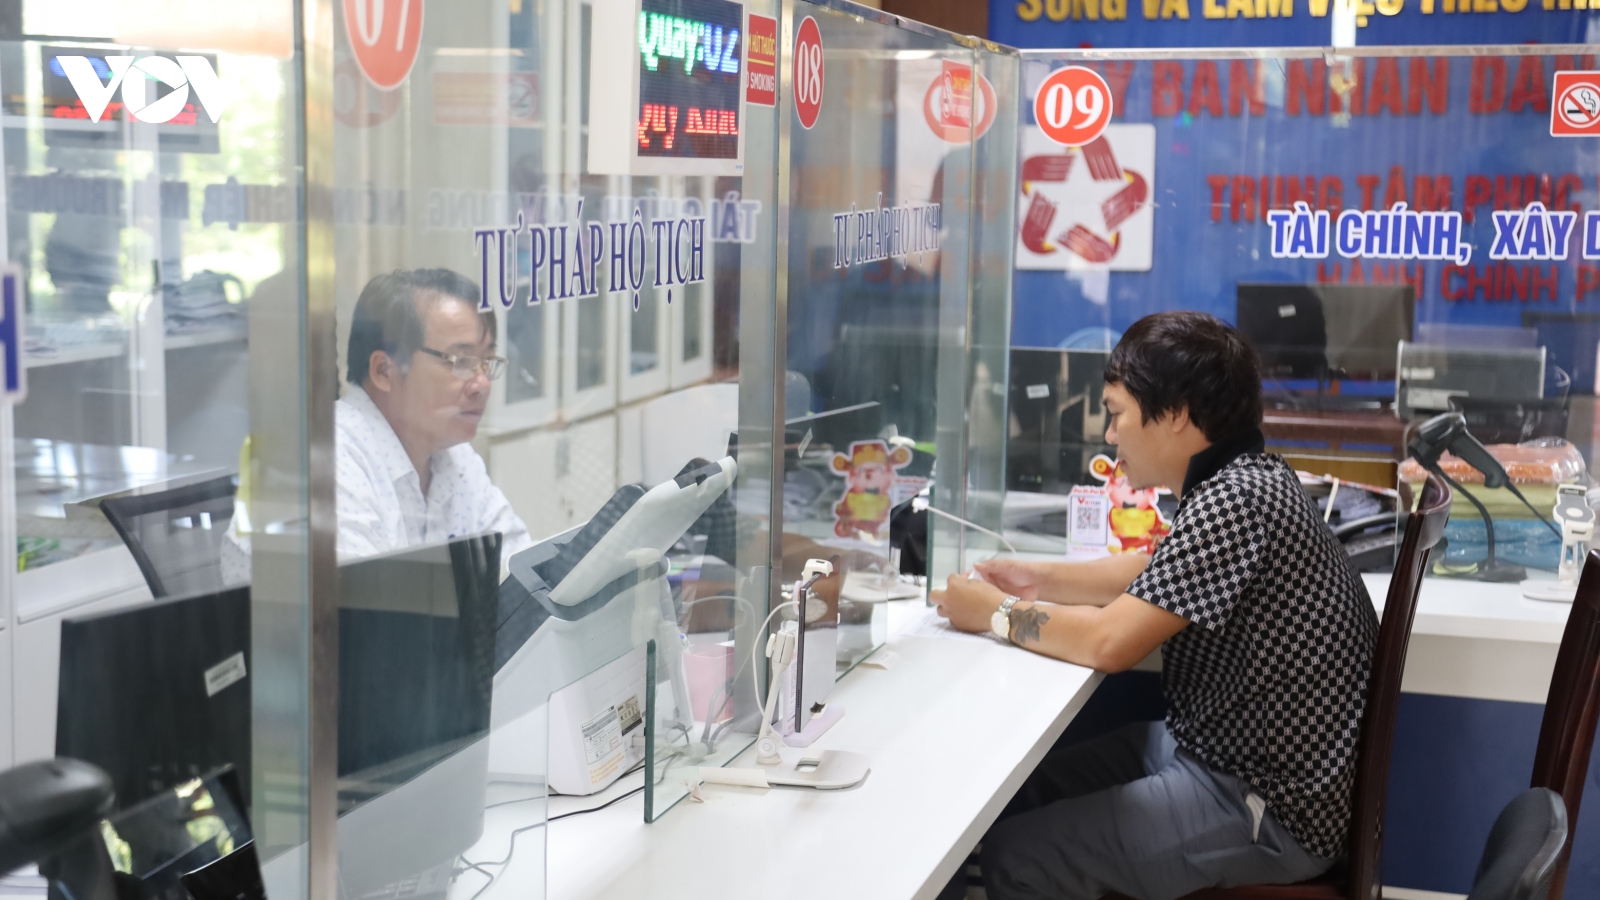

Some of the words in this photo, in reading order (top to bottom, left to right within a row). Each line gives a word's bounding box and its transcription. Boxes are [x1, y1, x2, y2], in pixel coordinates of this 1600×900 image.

[750, 72, 775, 91] SMOKING
[797, 40, 822, 105] 08
[1152, 59, 1266, 117] BAN
[1044, 82, 1104, 130] 09
[474, 209, 523, 312] TƯ
[528, 196, 604, 305] PHÁP
[608, 206, 646, 312] HỘ
[651, 216, 706, 305] TỊCH
[834, 202, 856, 269] TƯ
[856, 191, 891, 265] PHÁP
[891, 199, 910, 270] HỘ
[913, 203, 940, 267] TỊCH
[1267, 201, 1330, 258] TÀI
[1336, 201, 1471, 265] CHÍNH,
[1489, 201, 1577, 260] XÂY
